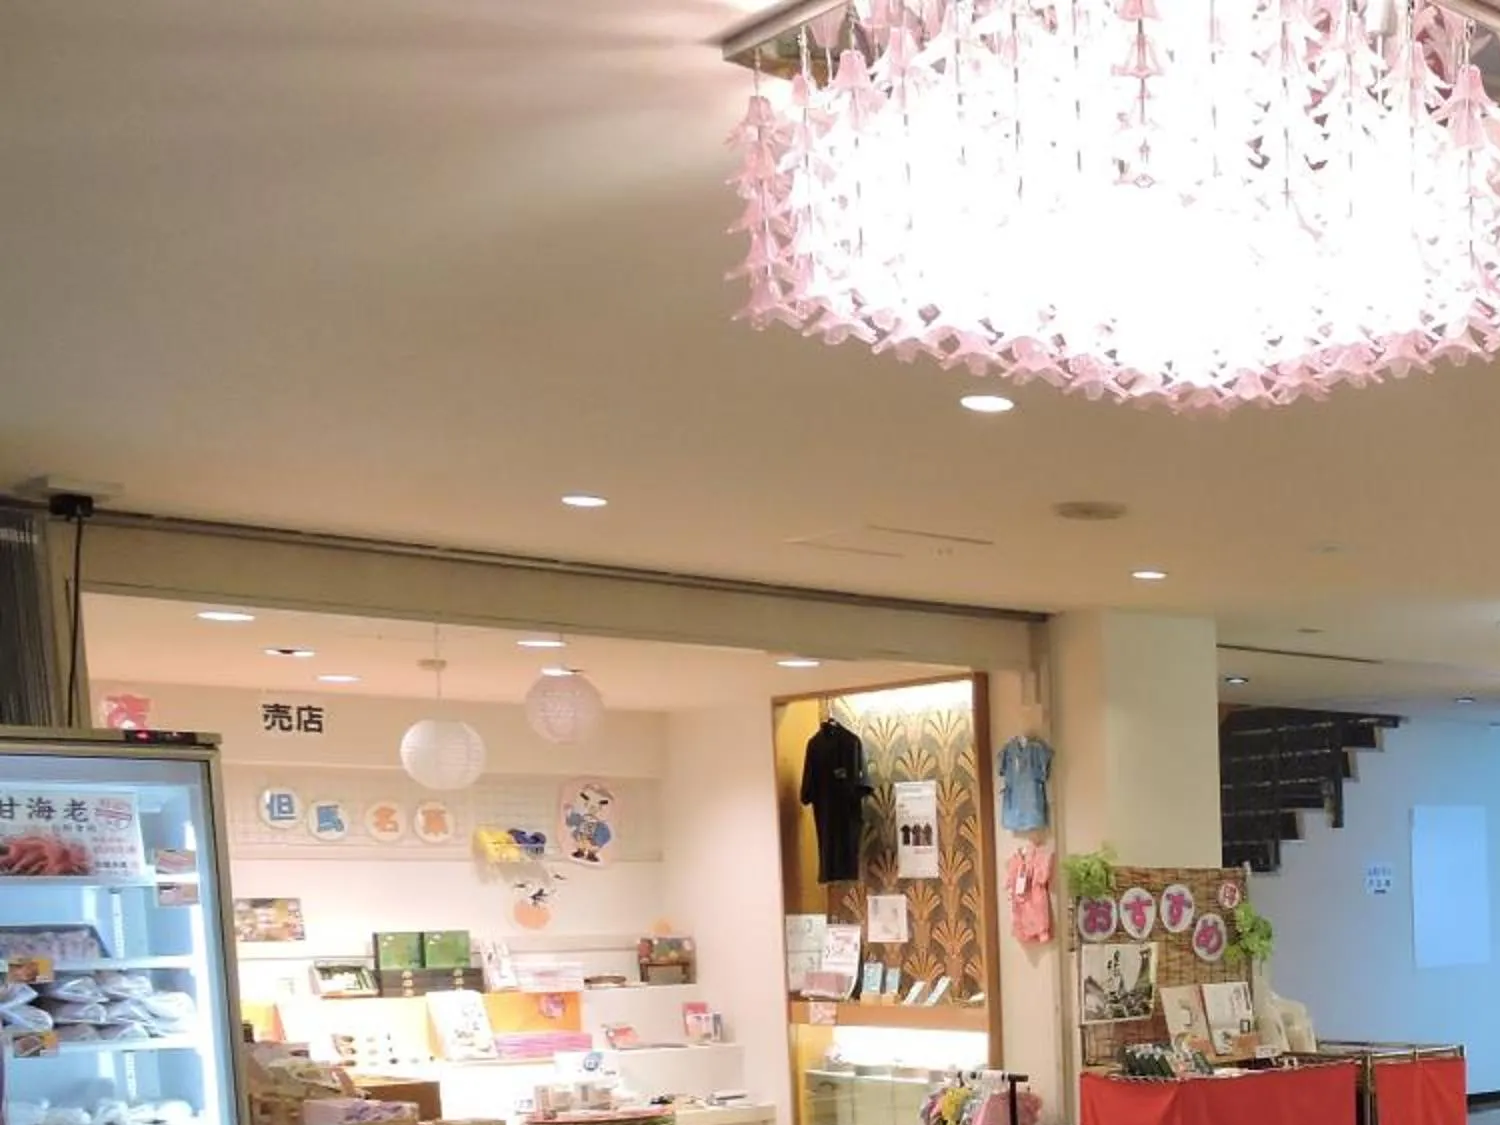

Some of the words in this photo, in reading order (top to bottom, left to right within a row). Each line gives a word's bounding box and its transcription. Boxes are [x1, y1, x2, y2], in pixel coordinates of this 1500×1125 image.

[262, 703, 324, 734] 売店
[0, 797, 89, 822] 甘海老
[1083, 892, 1223, 954] おすすめ
